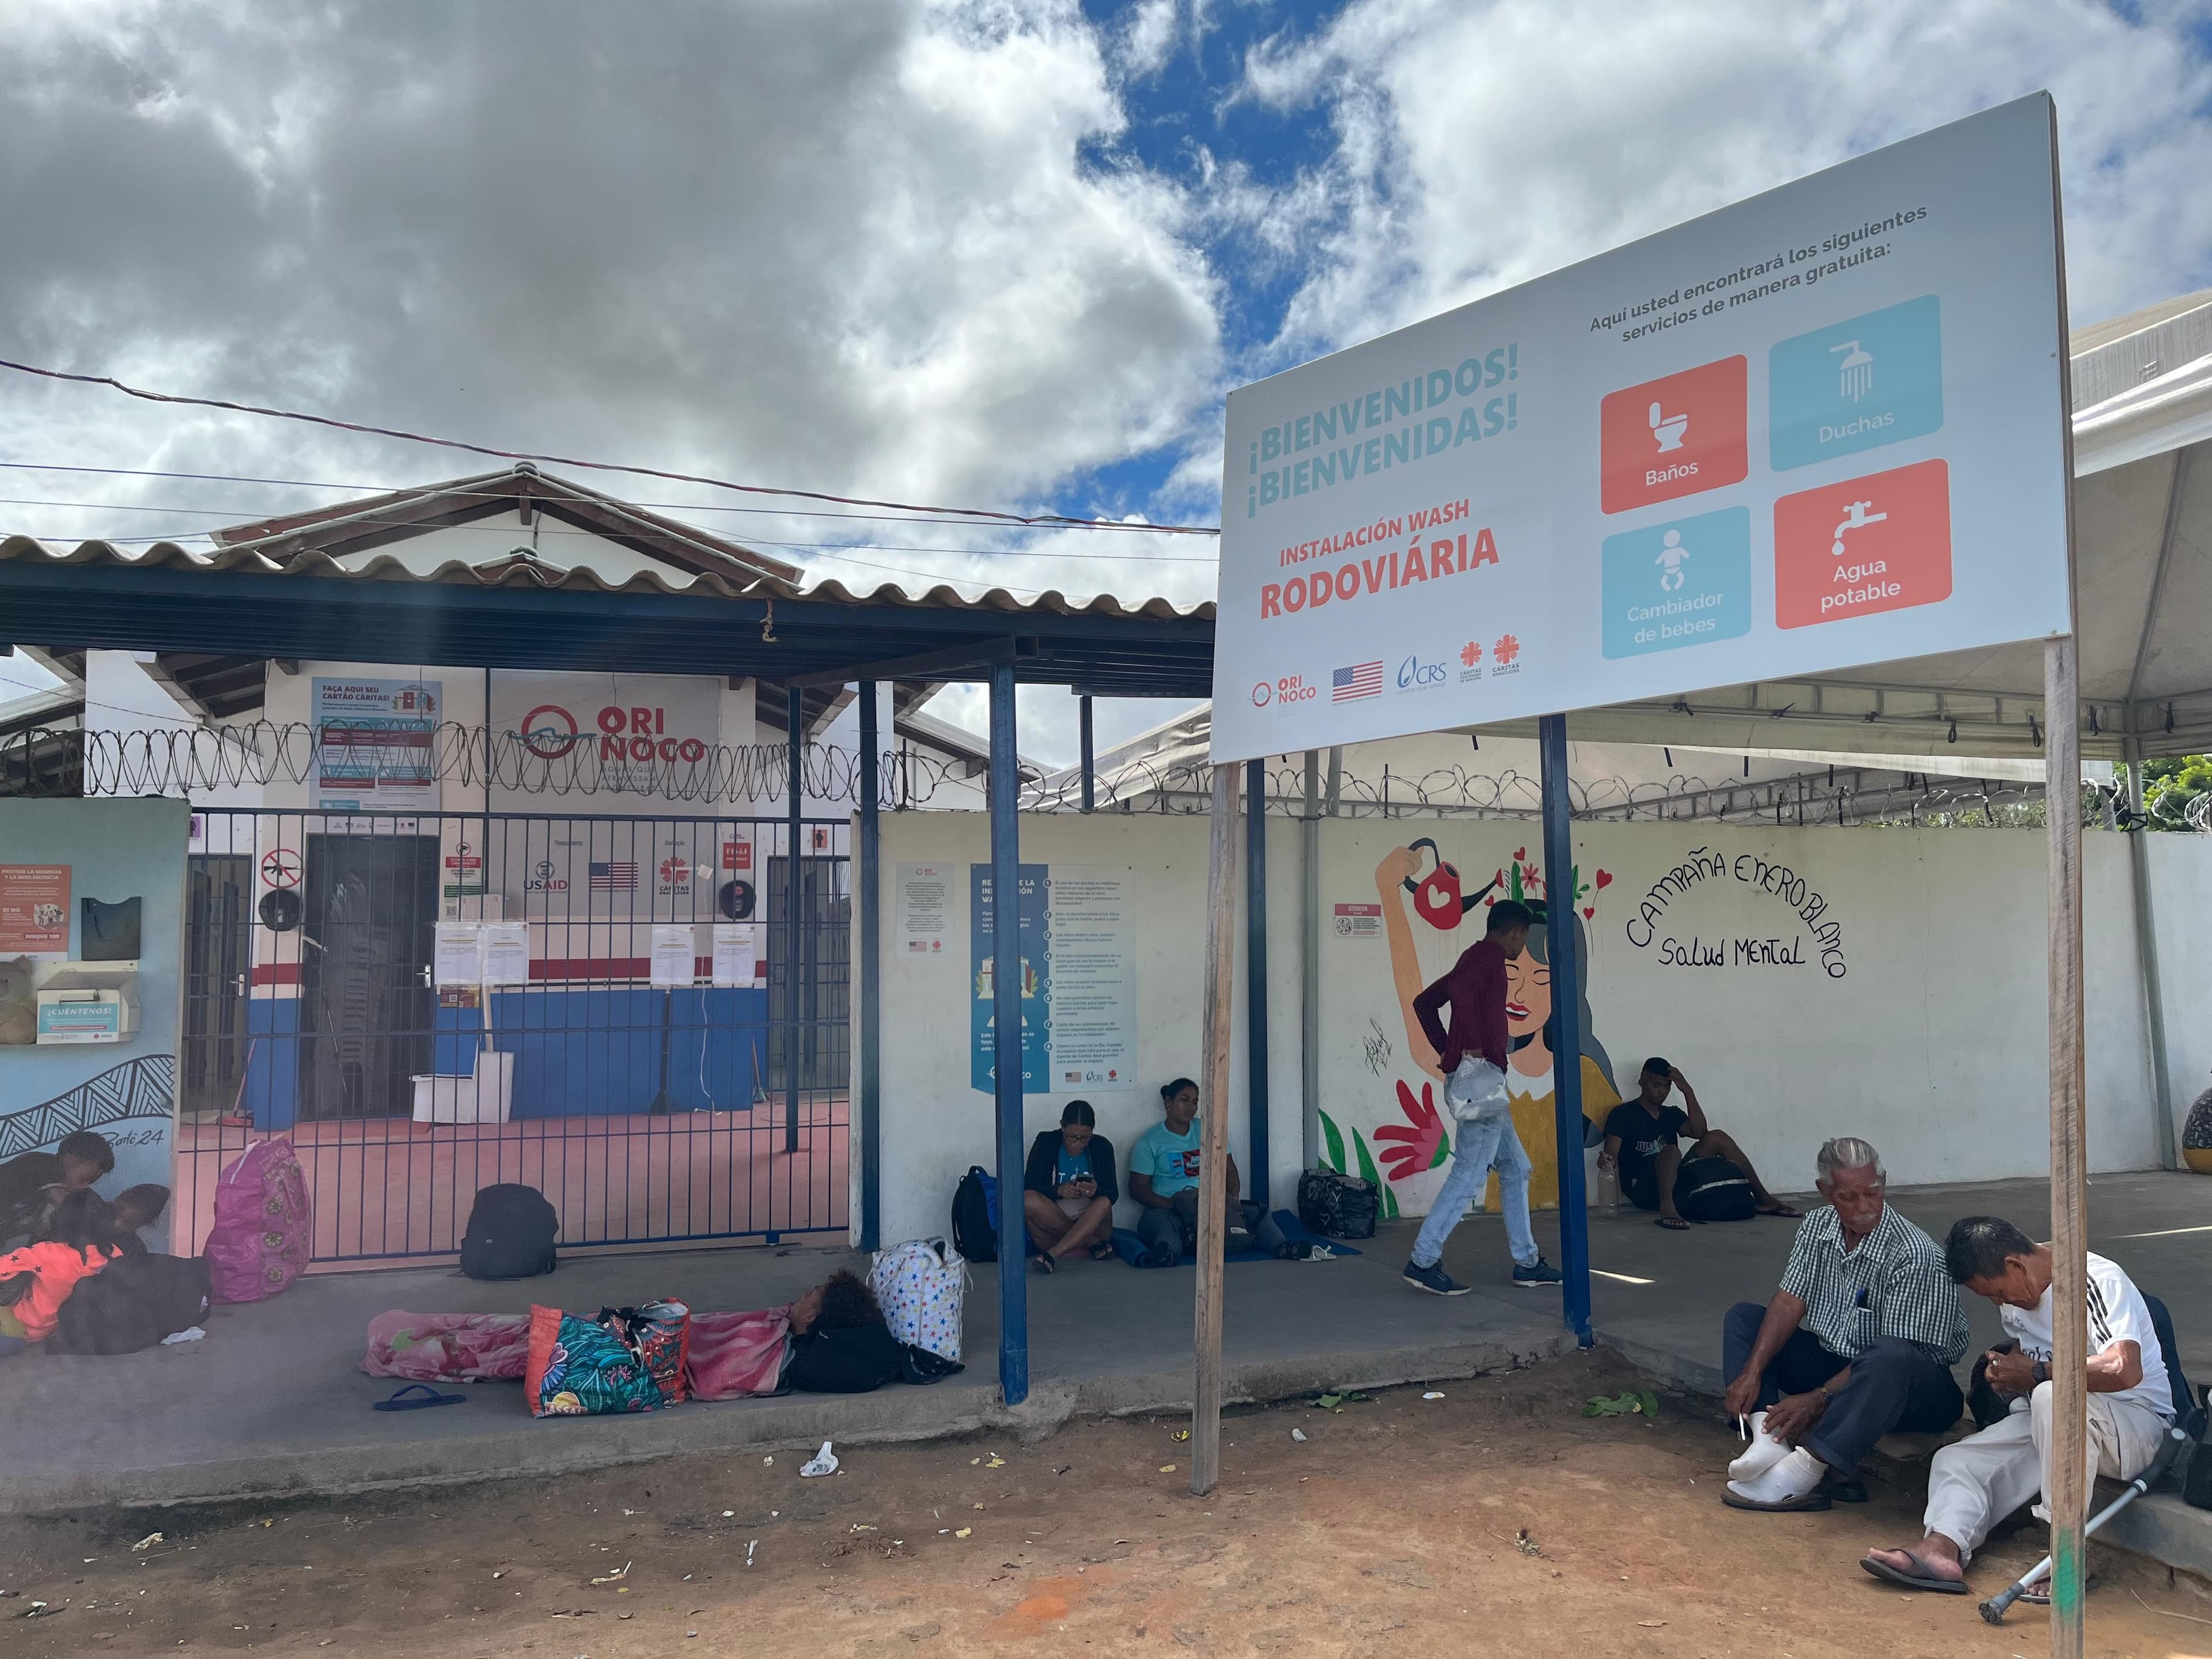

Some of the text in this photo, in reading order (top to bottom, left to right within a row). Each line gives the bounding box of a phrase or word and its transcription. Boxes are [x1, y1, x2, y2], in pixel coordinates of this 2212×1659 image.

[1590, 206, 1927, 332] Aquí usted encontrará los siguientes
[1622, 243, 1892, 343] servicios de manera gratuita:
[1249, 343, 1518, 475] ¡BIENVENIDOS!
[1819, 411, 1896, 444] Duchas
[1248, 392, 1518, 518] ¡BIENVENIDAS!
[1645, 461, 1699, 486] Baños
[1280, 499, 1469, 567] INSTALACIÓN WASH
[1261, 527, 1500, 620] RODOVIÁRIA
[1833, 559, 1887, 584] Agua
[1627, 592, 1724, 622] Cambiador
[1820, 581, 1902, 613] potable
[1634, 618, 1716, 644] de bebes
[1278, 675, 1302, 691] ORI
[1416, 662, 1446, 684] CRS
[323, 685, 342, 693] FAÇA
[1278, 686, 1317, 704] NOCO
[597, 706, 664, 734] ORI
[600, 737, 705, 762] NOCO
[524, 880, 568, 890] USAID
